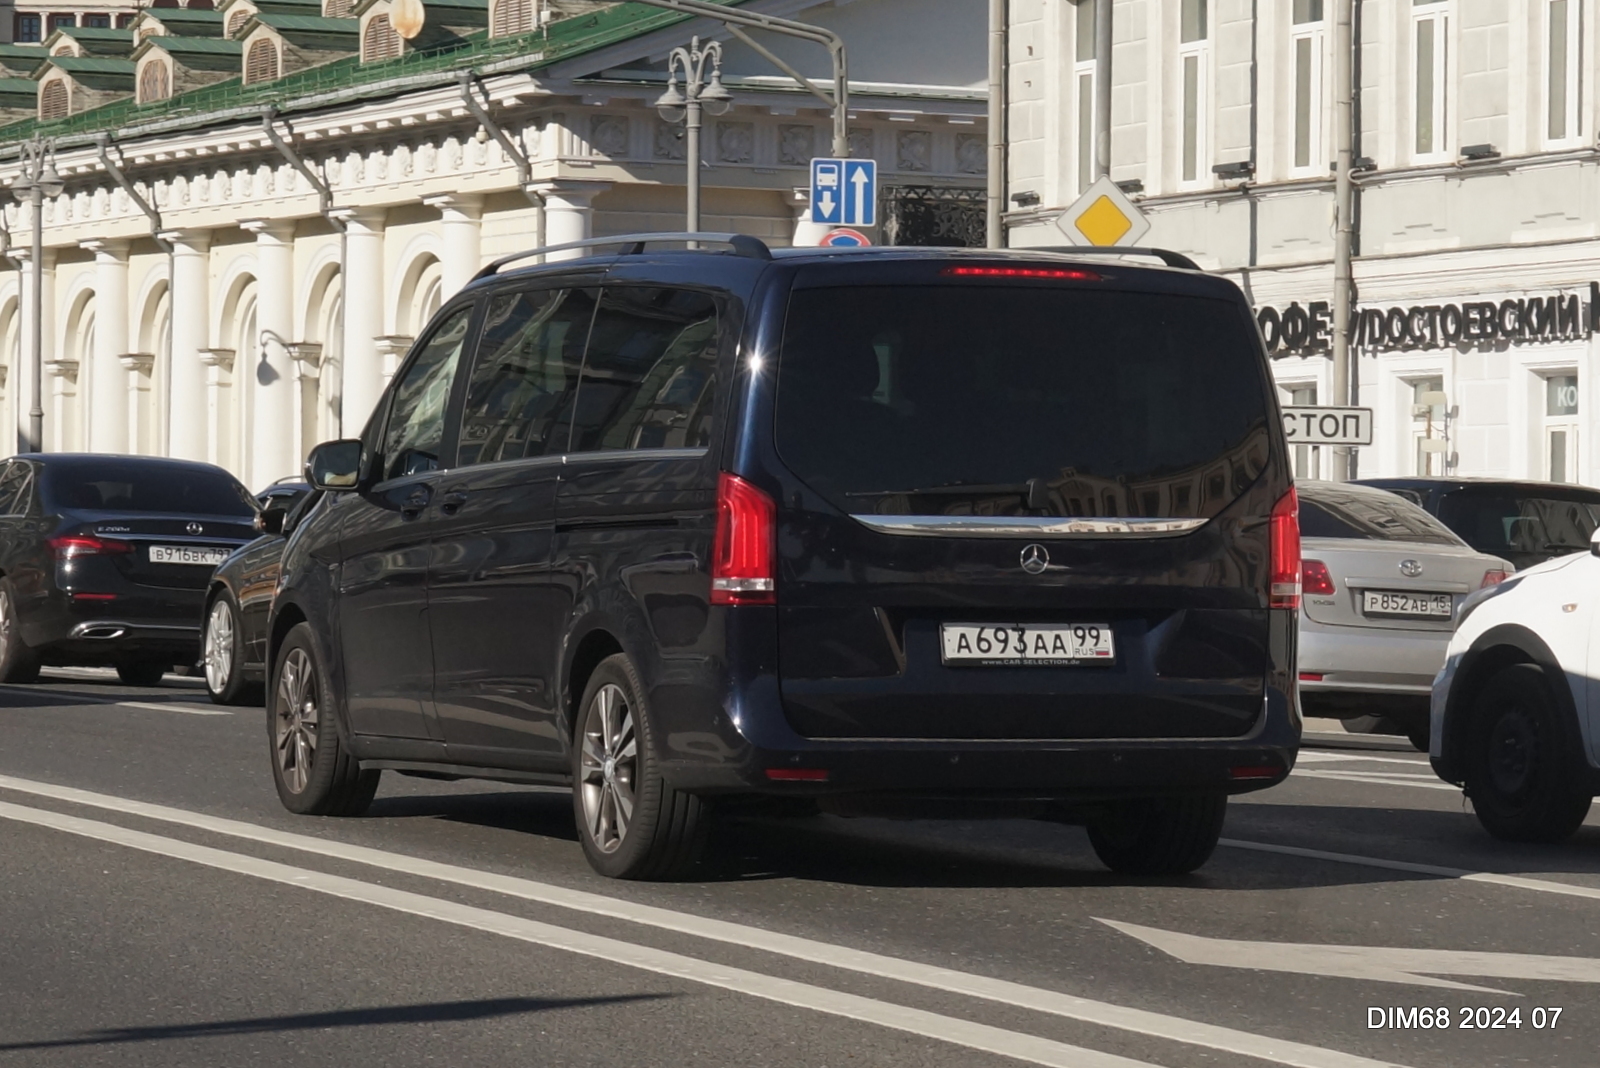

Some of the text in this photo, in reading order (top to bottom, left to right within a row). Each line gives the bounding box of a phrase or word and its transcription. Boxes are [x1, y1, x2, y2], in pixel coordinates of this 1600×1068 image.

[1253, 301, 1329, 351] ОФЕ
[1283, 412, 1359, 438] СТОП
[156, 546, 208, 562] В916ВК
[1370, 594, 1429, 612] Р852АВ
[1432, 596, 1447, 609] 15
[957, 626, 1101, 655] А693АА 99
[1074, 647, 1095, 657] RUS
